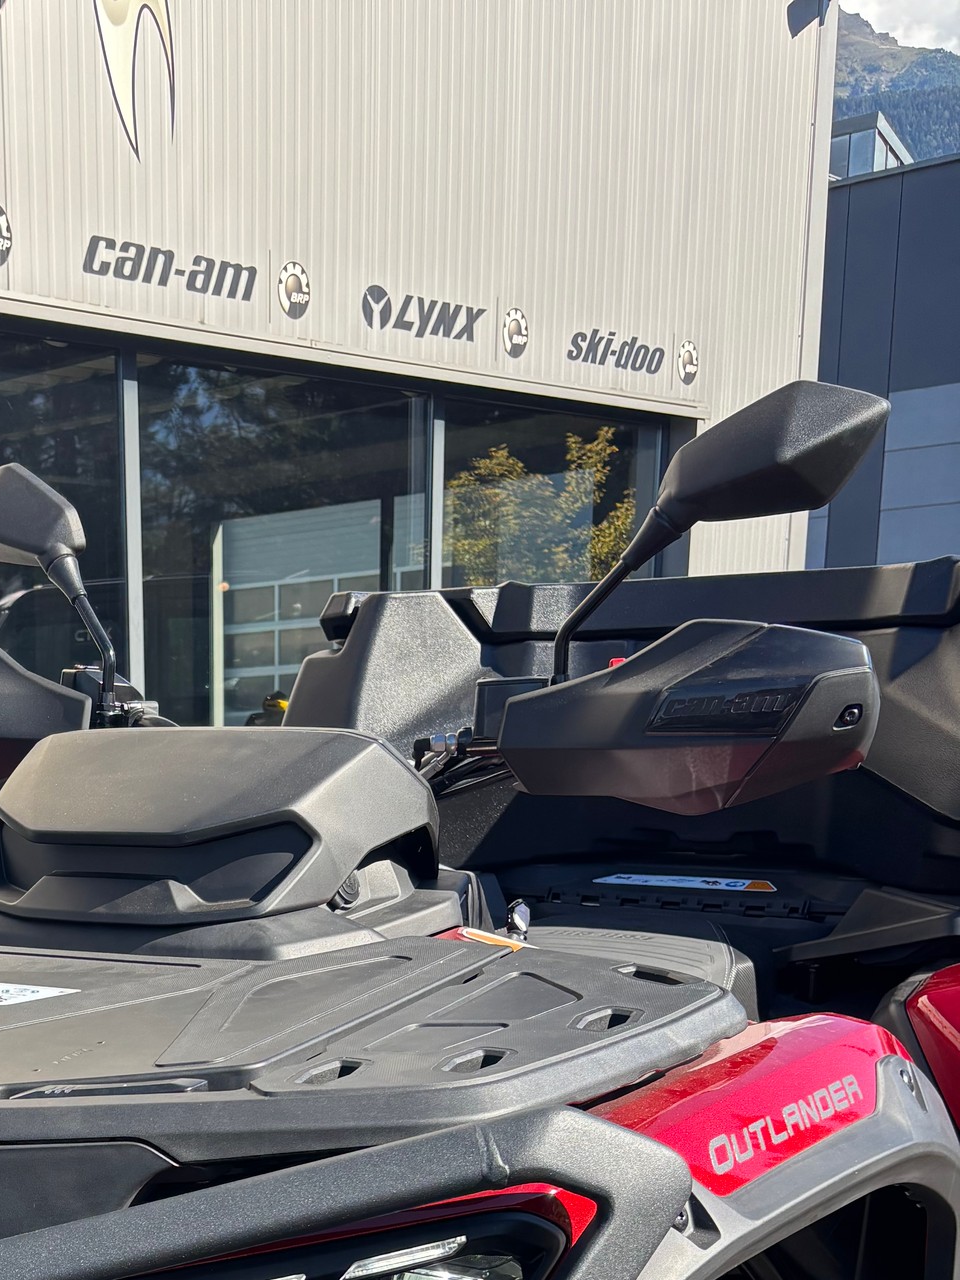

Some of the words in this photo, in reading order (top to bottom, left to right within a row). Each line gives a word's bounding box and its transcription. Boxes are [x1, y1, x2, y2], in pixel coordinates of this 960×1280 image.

[82, 234, 258, 302] can-am
[290, 292, 310, 304] BRP
[391, 294, 488, 343] LYNX
[566, 328, 666, 375] ski-doo
[708, 1074, 864, 1176] OUTLANDER
